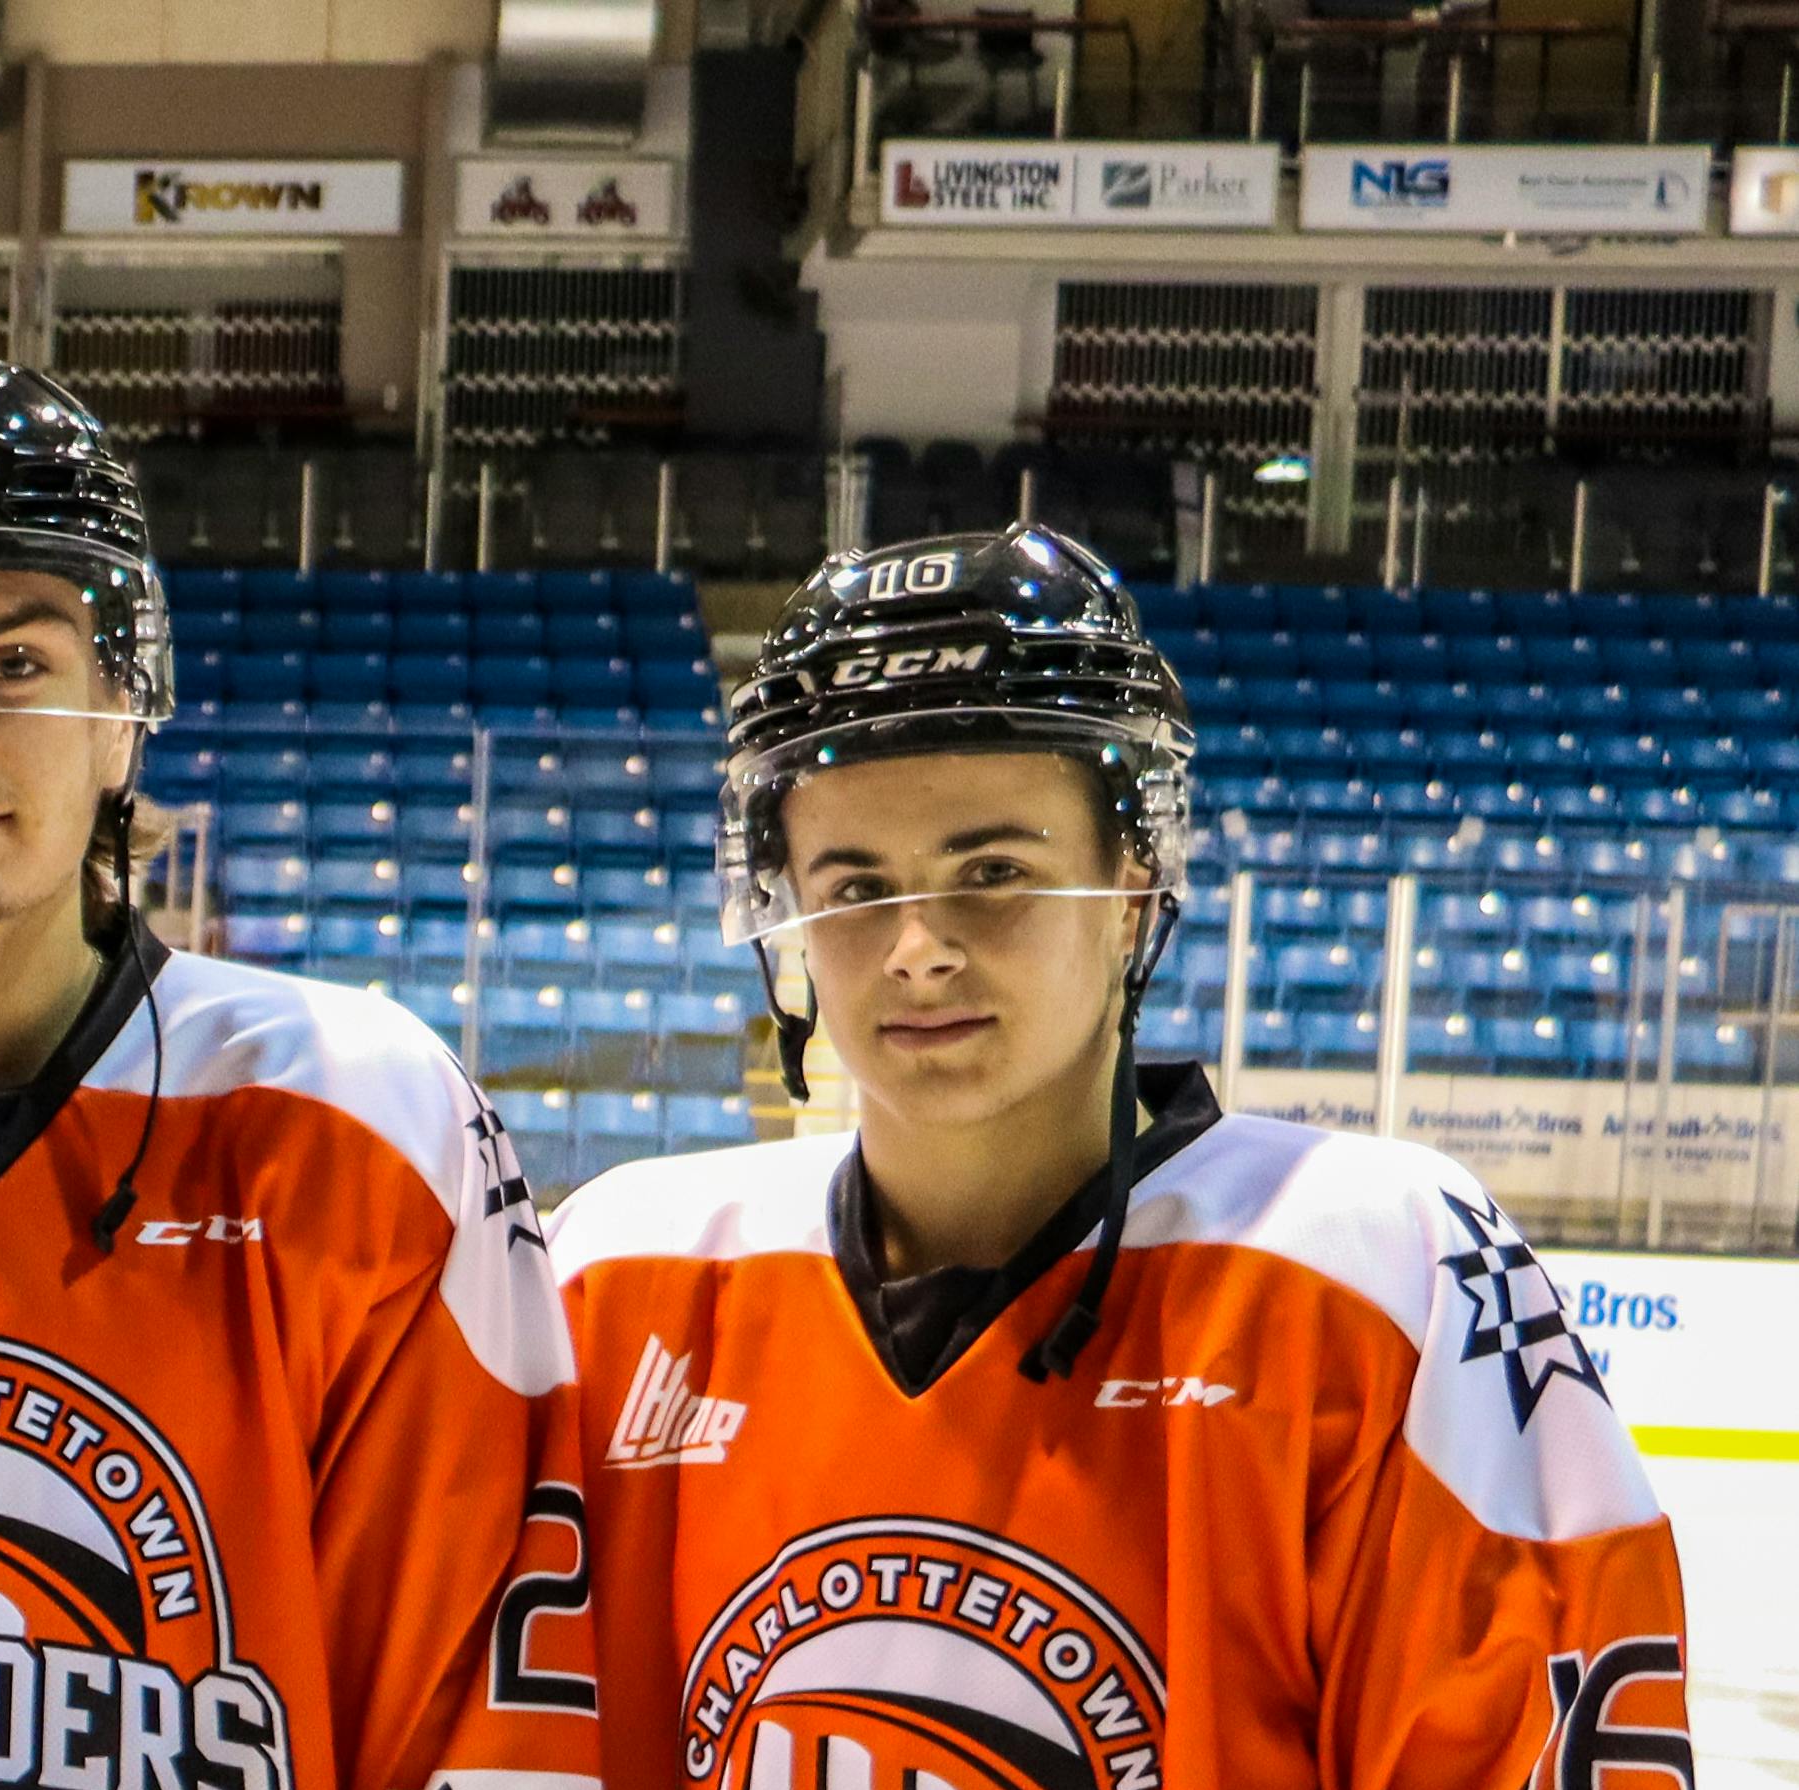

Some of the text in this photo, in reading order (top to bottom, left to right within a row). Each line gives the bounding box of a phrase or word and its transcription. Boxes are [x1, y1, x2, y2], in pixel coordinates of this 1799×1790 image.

[933, 160, 1060, 185] LIVINGSTON
[1159, 160, 1250, 197] Parker
[933, 187, 1000, 210] STEEL
[869, 552, 958, 601] 16
[832, 644, 990, 687] CCM
[487, 1480, 599, 1720] 2
